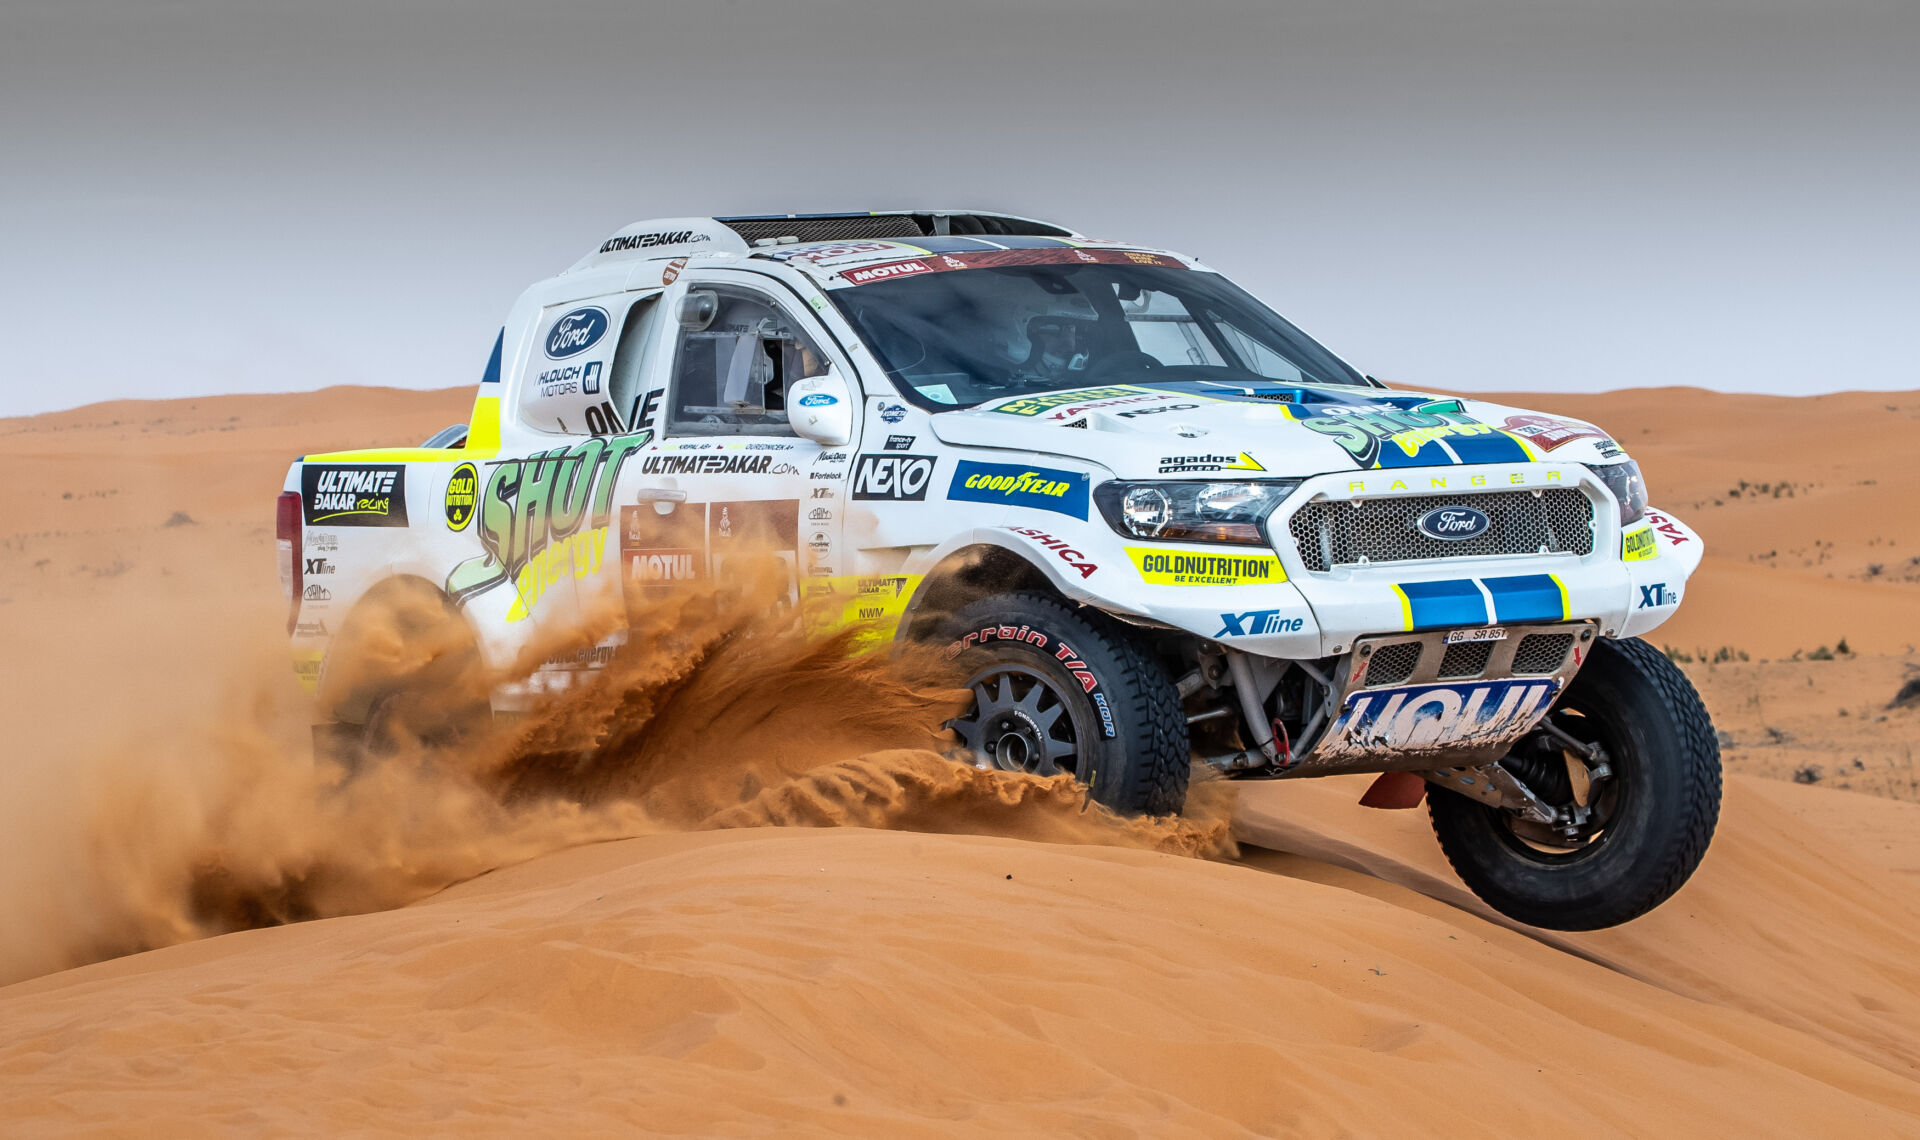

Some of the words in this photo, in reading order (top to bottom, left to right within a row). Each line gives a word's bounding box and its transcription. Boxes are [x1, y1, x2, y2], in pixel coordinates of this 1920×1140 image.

[853, 262, 925, 281] MOTUL
[551, 312, 595, 352] Ford
[540, 366, 582, 383] HLOUCH
[541, 382, 578, 398] MOTORS
[1046, 395, 1181, 421] YASHICA
[1116, 403, 1200, 418] NEXO
[1302, 400, 1484, 470] SHOT
[1391, 423, 1496, 458] energy
[1159, 465, 1221, 473] TRAILERS
[1160, 454, 1237, 465] agados
[317, 471, 397, 494] ULTIMATE
[814, 472, 842, 480] Fortelock
[855, 458, 932, 499] NEXO
[965, 471, 1070, 497] GOODYEAR
[1348, 471, 1560, 492] RANGER
[314, 493, 357, 510] DAKAR
[356, 493, 390, 516] racing
[445, 428, 654, 607] SHOT
[1437, 510, 1477, 532] Ford
[304, 558, 336, 575] XTline
[506, 526, 608, 623] energy
[632, 555, 696, 581] MOTUL
[1143, 554, 1270, 578] GOLDNUTRITION
[1174, 574, 1186, 583] BE
[1188, 575, 1238, 585] EXCELLENT
[1638, 582, 1677, 609] XTline
[858, 608, 884, 619] NWM
[1213, 609, 1304, 639] XTline
[1450, 631, 1465, 642] GG
[1472, 630, 1487, 640] SR
